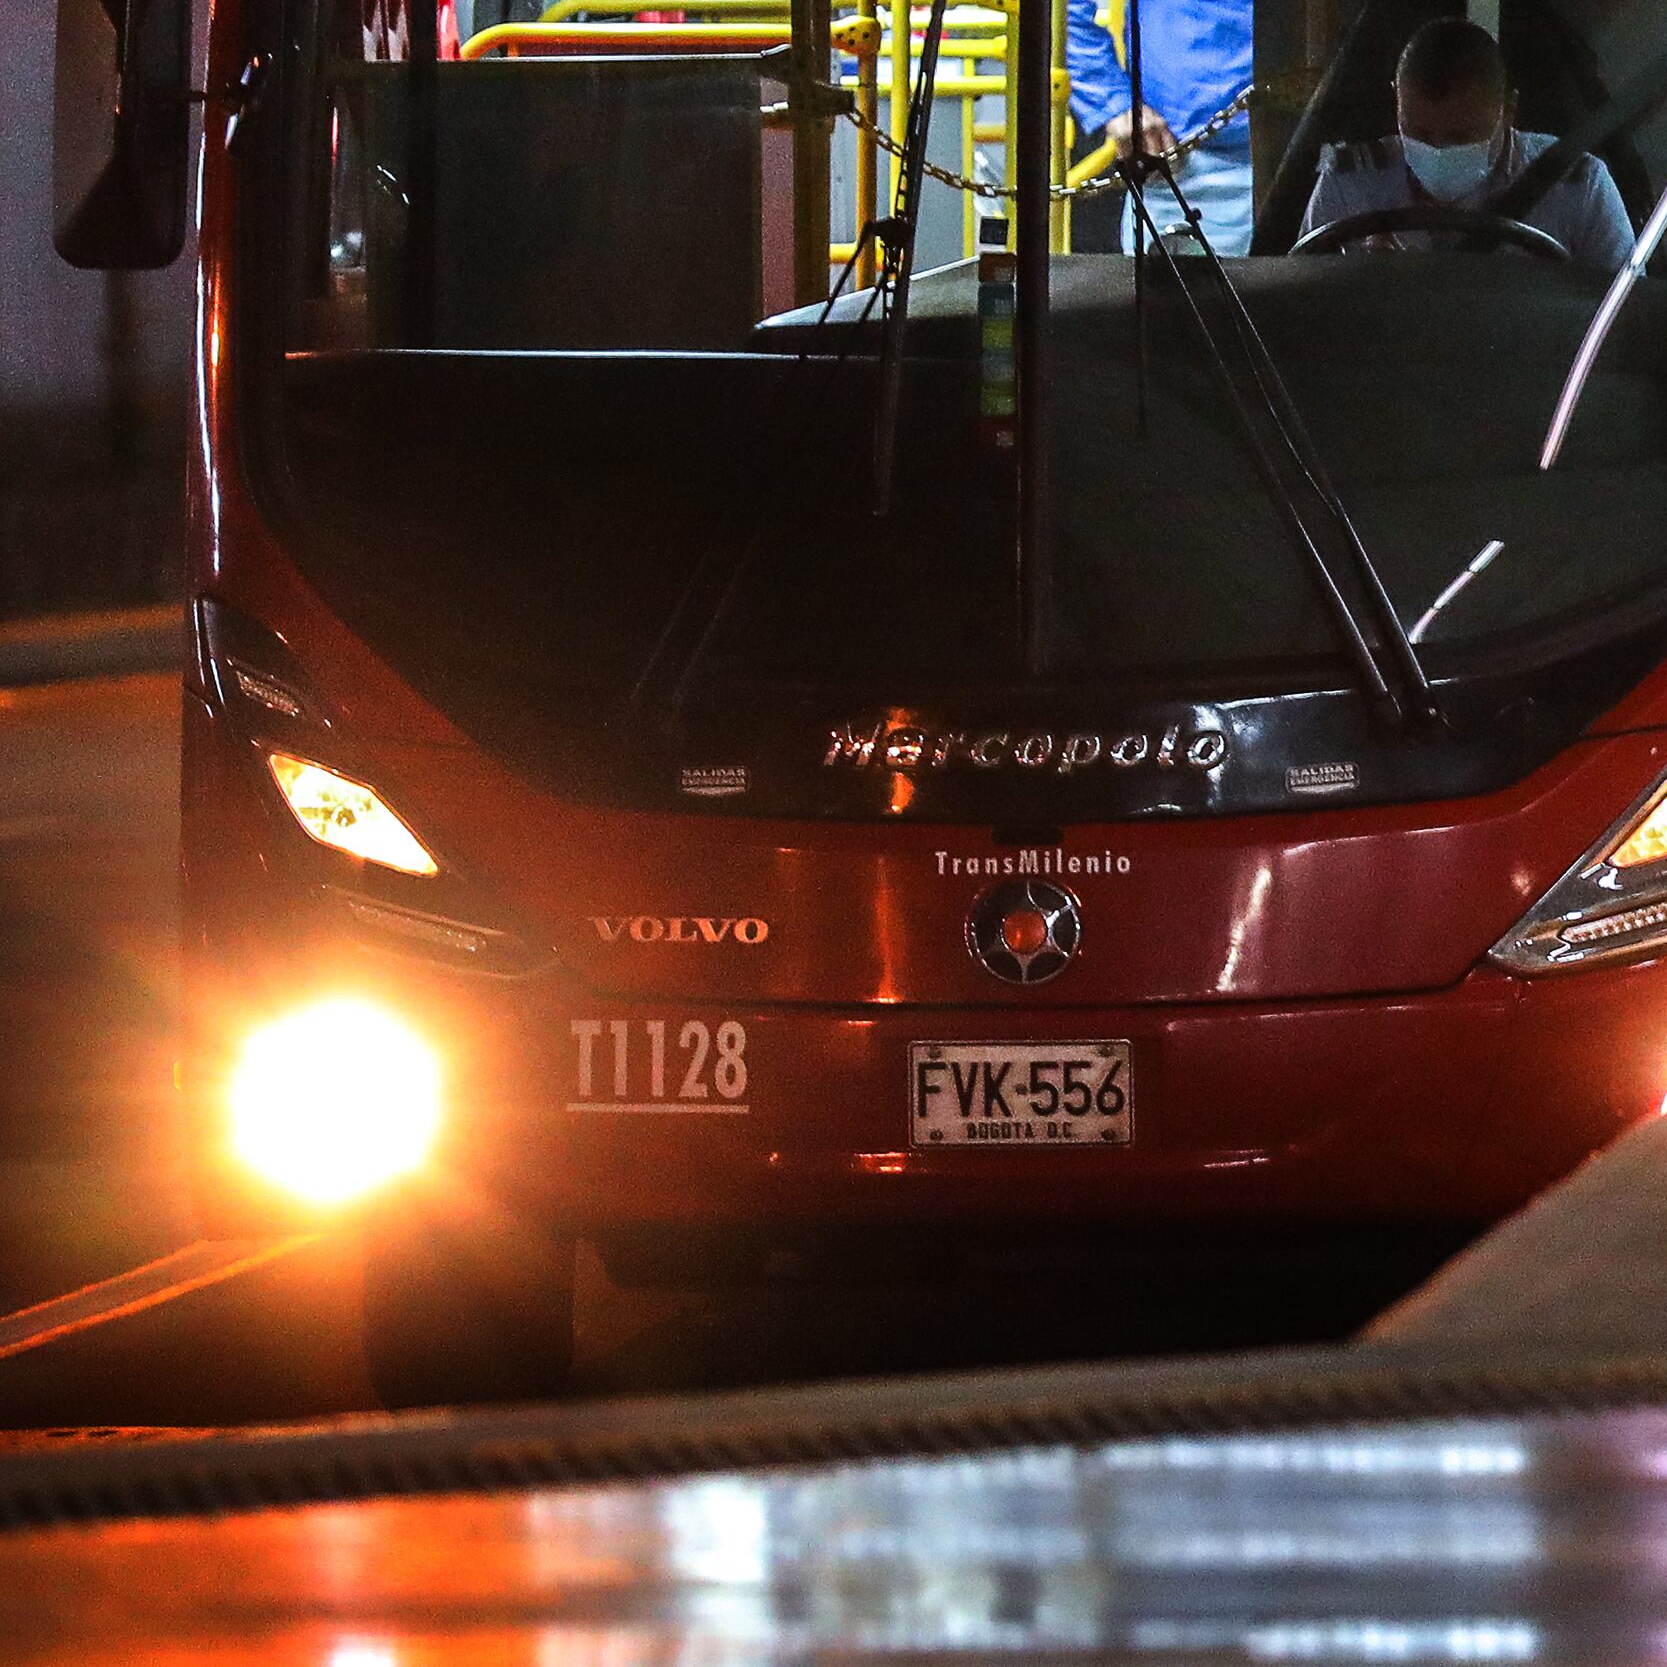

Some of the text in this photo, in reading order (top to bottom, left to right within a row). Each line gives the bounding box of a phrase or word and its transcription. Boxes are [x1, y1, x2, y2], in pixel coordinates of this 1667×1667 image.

[823, 723, 1227, 774] Marcopolo
[934, 848, 1131, 875] TransMilenio
[587, 916, 769, 944] VOLVO
[570, 1019, 747, 1099] T1128
[917, 1059, 1125, 1118] FVK-556
